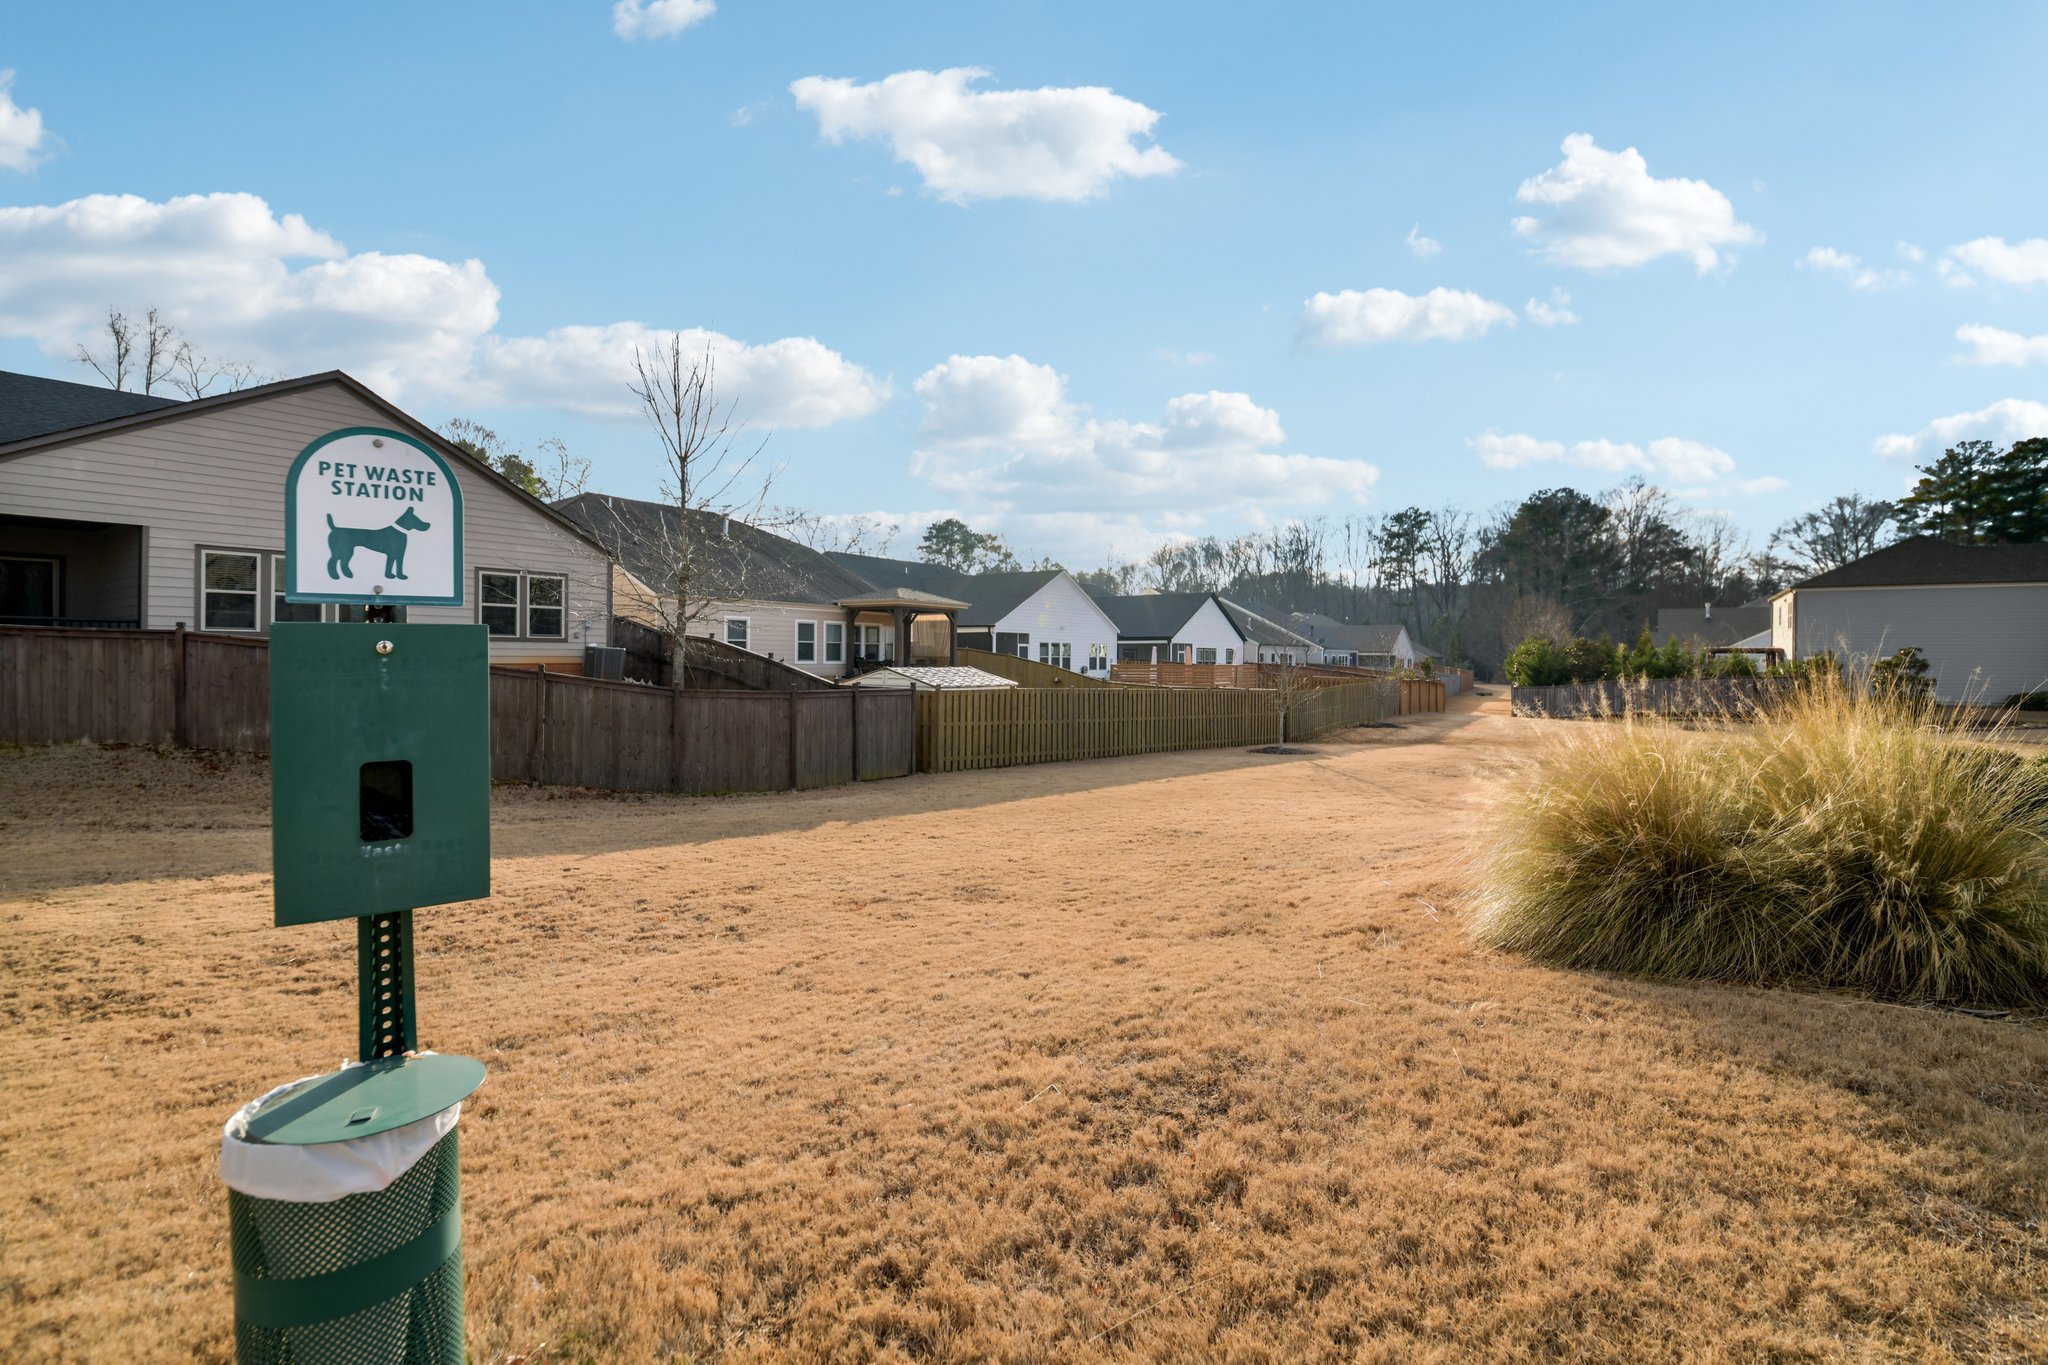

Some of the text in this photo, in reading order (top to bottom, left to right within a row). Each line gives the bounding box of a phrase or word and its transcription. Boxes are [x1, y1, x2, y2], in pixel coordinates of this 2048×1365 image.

[318, 461, 437, 486] PET WASTE
[331, 480, 424, 502] STATION
